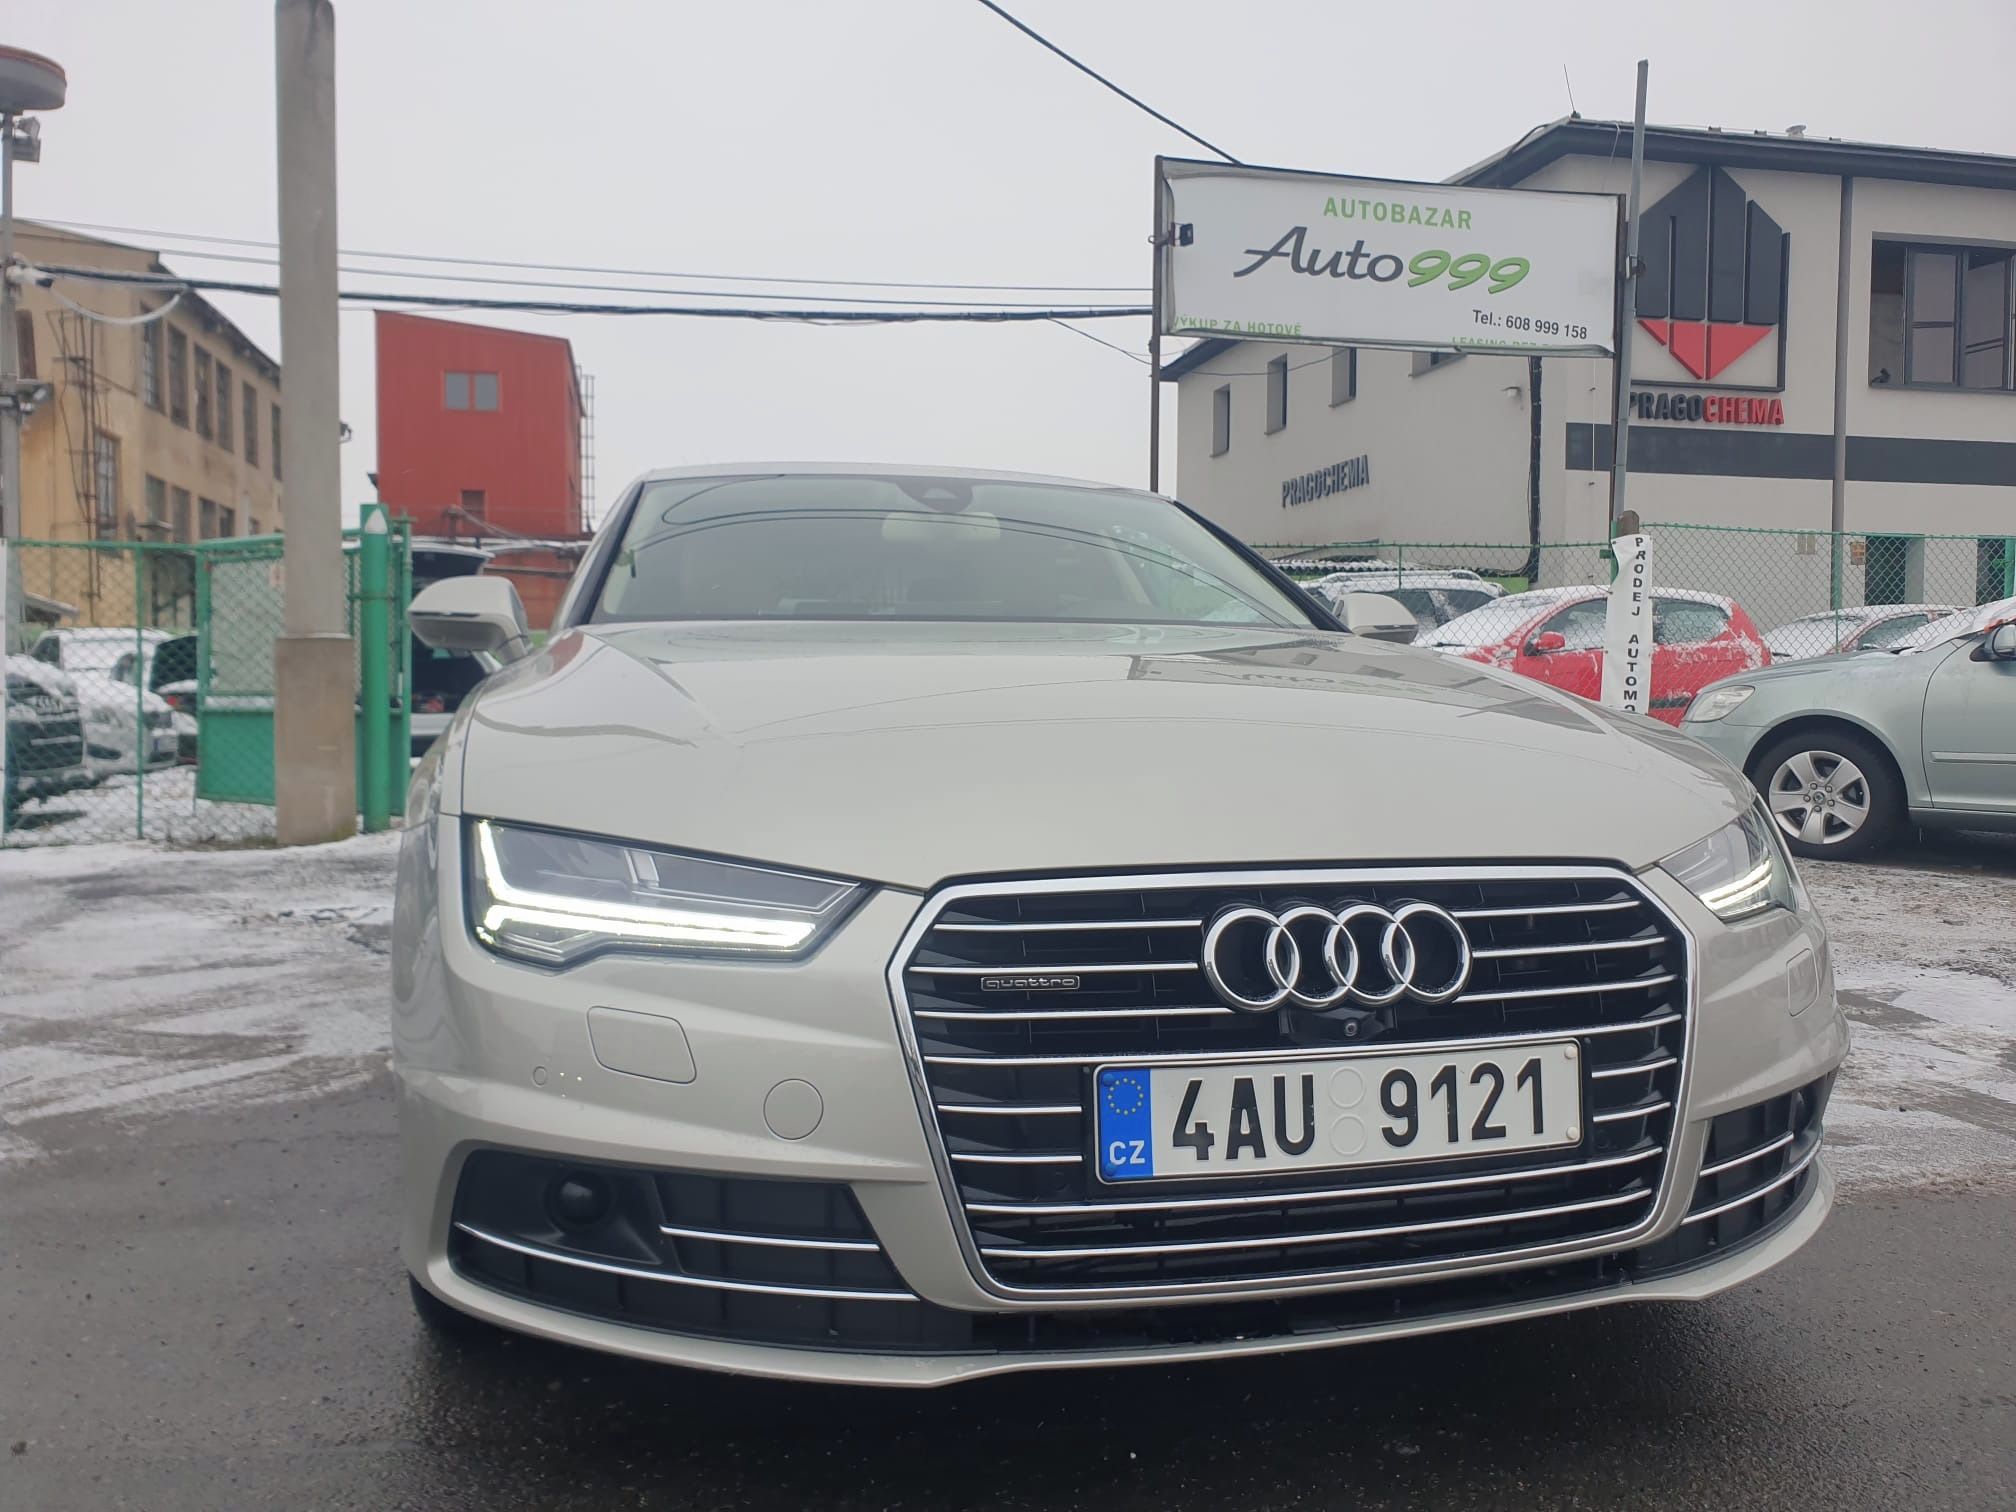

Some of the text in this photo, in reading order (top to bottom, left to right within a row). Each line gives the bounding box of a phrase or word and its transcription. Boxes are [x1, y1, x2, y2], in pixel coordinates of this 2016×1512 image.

[1323, 197, 1472, 230] AUTOBAZAR
[1233, 226, 1530, 294] Auto999
[1223, 320, 1241, 332] ZA
[1247, 321, 1302, 336] HOTOVÉ
[1472, 309, 1588, 340] Tel.: 608 999 158
[1282, 454, 1370, 509] PRAGOCHEMA
[1631, 537, 1646, 616] PRODEJ
[986, 977, 1075, 989] quattro
[1172, 1057, 1544, 1161] 4AU 9121
[1109, 1140, 1145, 1165] CZ
